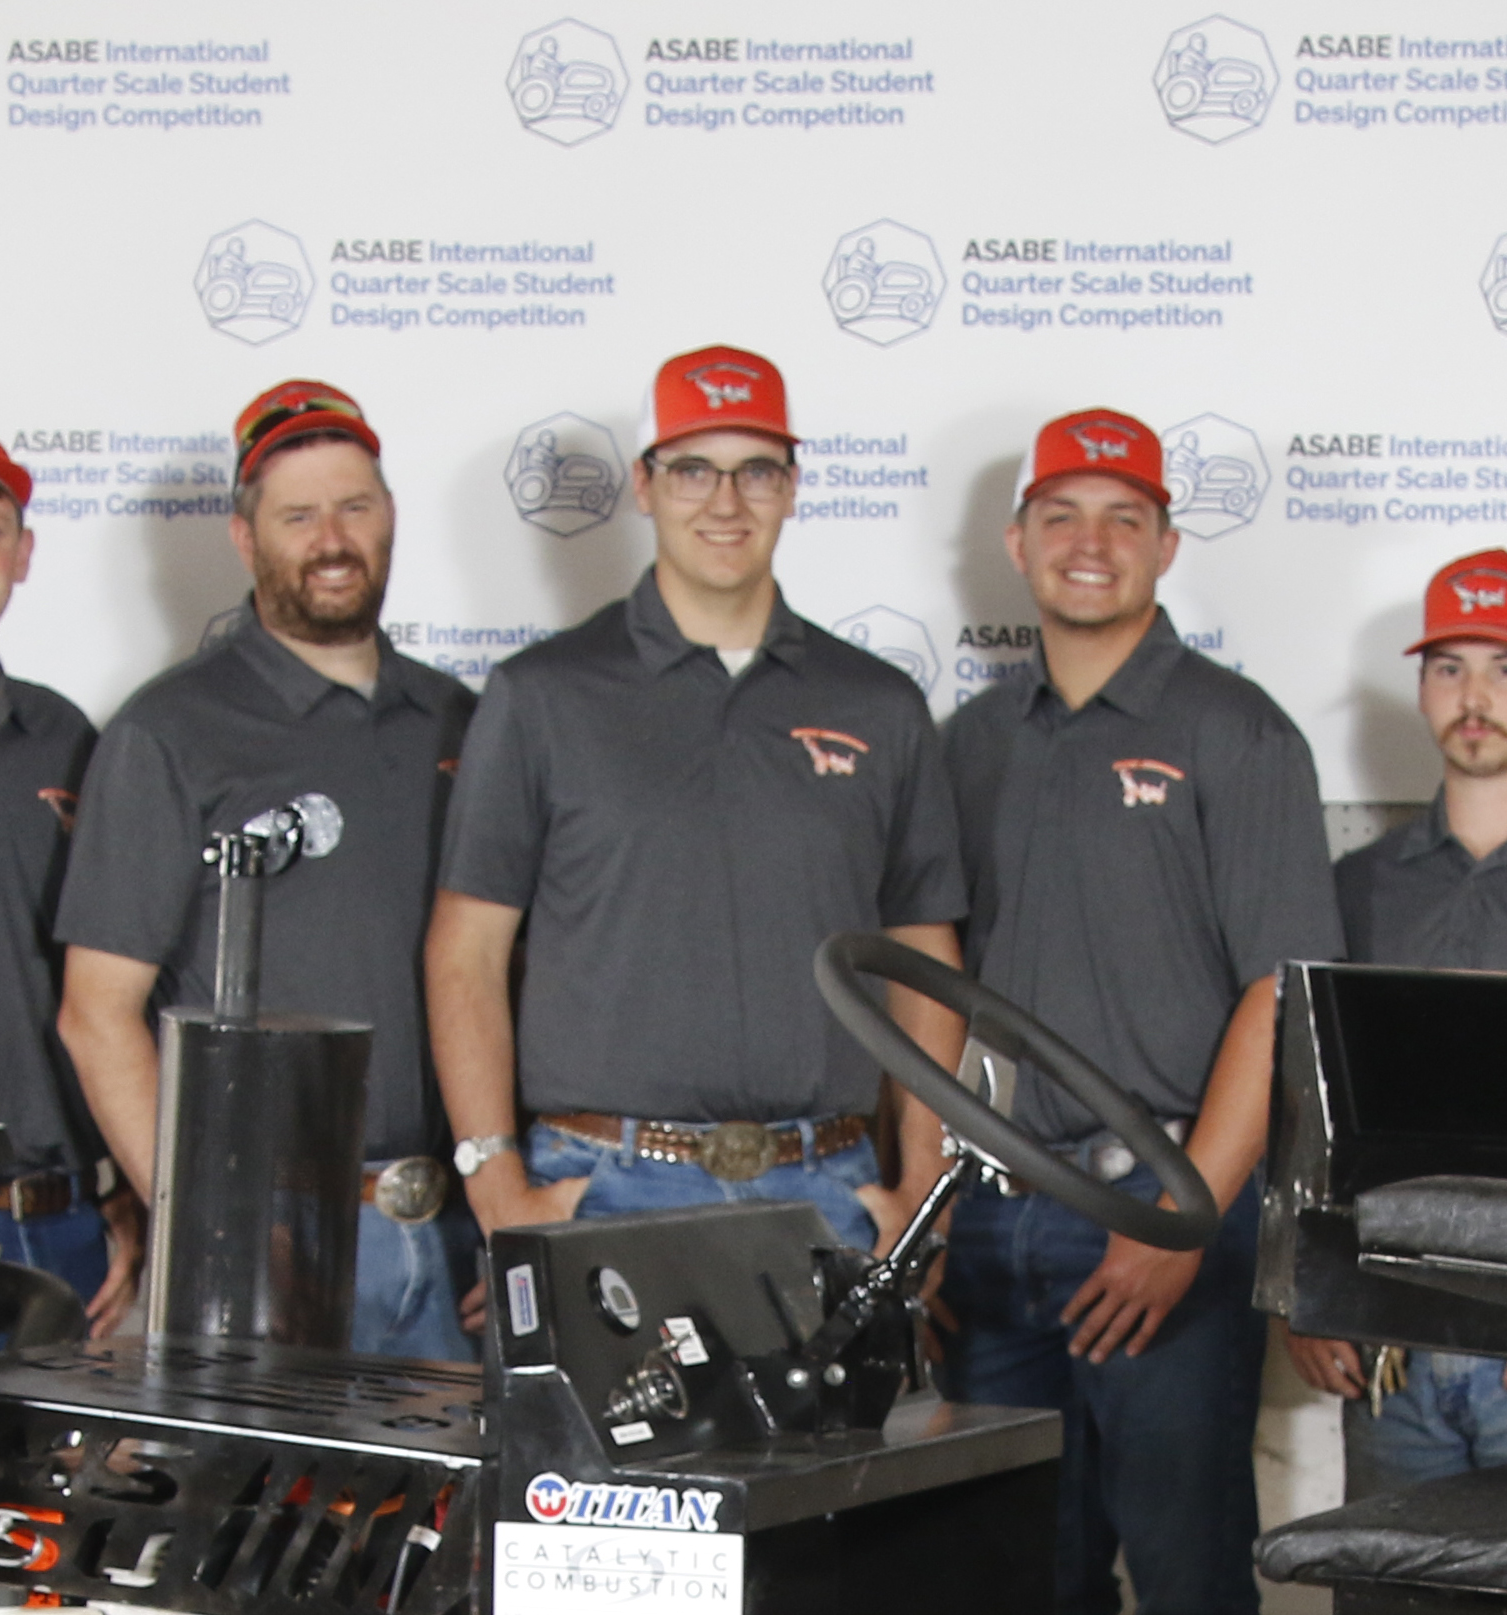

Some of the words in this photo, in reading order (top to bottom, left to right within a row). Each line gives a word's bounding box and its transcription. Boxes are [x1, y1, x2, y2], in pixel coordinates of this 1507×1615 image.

[7, 39, 99, 64] ASABE
[105, 40, 269, 62] International
[645, 37, 739, 62] ASABE
[746, 37, 913, 61] International
[1296, 34, 1392, 59] ASABE
[7, 71, 107, 97] Quarter
[113, 71, 183, 94] Scale
[189, 71, 290, 95] Student
[644, 70, 747, 96] Quarter
[753, 70, 825, 94] Scale
[831, 69, 934, 93] Student
[1294, 67, 1400, 93] Quarter
[1406, 67, 1479, 91] Scale
[8, 103, 97, 131] Design
[102, 103, 262, 130] Competition
[645, 102, 736, 131] Design
[741, 102, 905, 130] Competition
[1294, 100, 1388, 129] Design
[330, 239, 423, 264] ASABE
[429, 240, 594, 263] International
[962, 238, 1058, 263] ASABE
[1064, 240, 1232, 262] International
[330, 271, 431, 296] Quarter
[437, 271, 507, 295] Scale
[514, 271, 615, 295] Student
[961, 270, 1065, 297] Quarter
[1071, 270, 1143, 295] Scale
[1149, 270, 1254, 295] Student
[331, 302, 420, 331] Design
[426, 303, 586, 330] Competition
[962, 302, 1053, 331] Design
[1058, 302, 1223, 330] Competition
[11, 430, 103, 453] ASABE
[801, 433, 908, 455] national
[1286, 433, 1383, 458] ASABE
[29, 462, 110, 485] uarter
[115, 462, 186, 485] Scale
[825, 464, 930, 487] Student
[1286, 465, 1390, 491] Quarter
[1396, 466, 1469, 489] Scale
[29, 494, 98, 519] esign
[798, 496, 899, 522] petition
[1286, 497, 1378, 526] Design
[956, 625, 1042, 648] ASAB
[567, 1480, 722, 1530] TITAN
[504, 1541, 728, 1572] CATALYTIC
[504, 1570, 728, 1600] COMBUSTION
